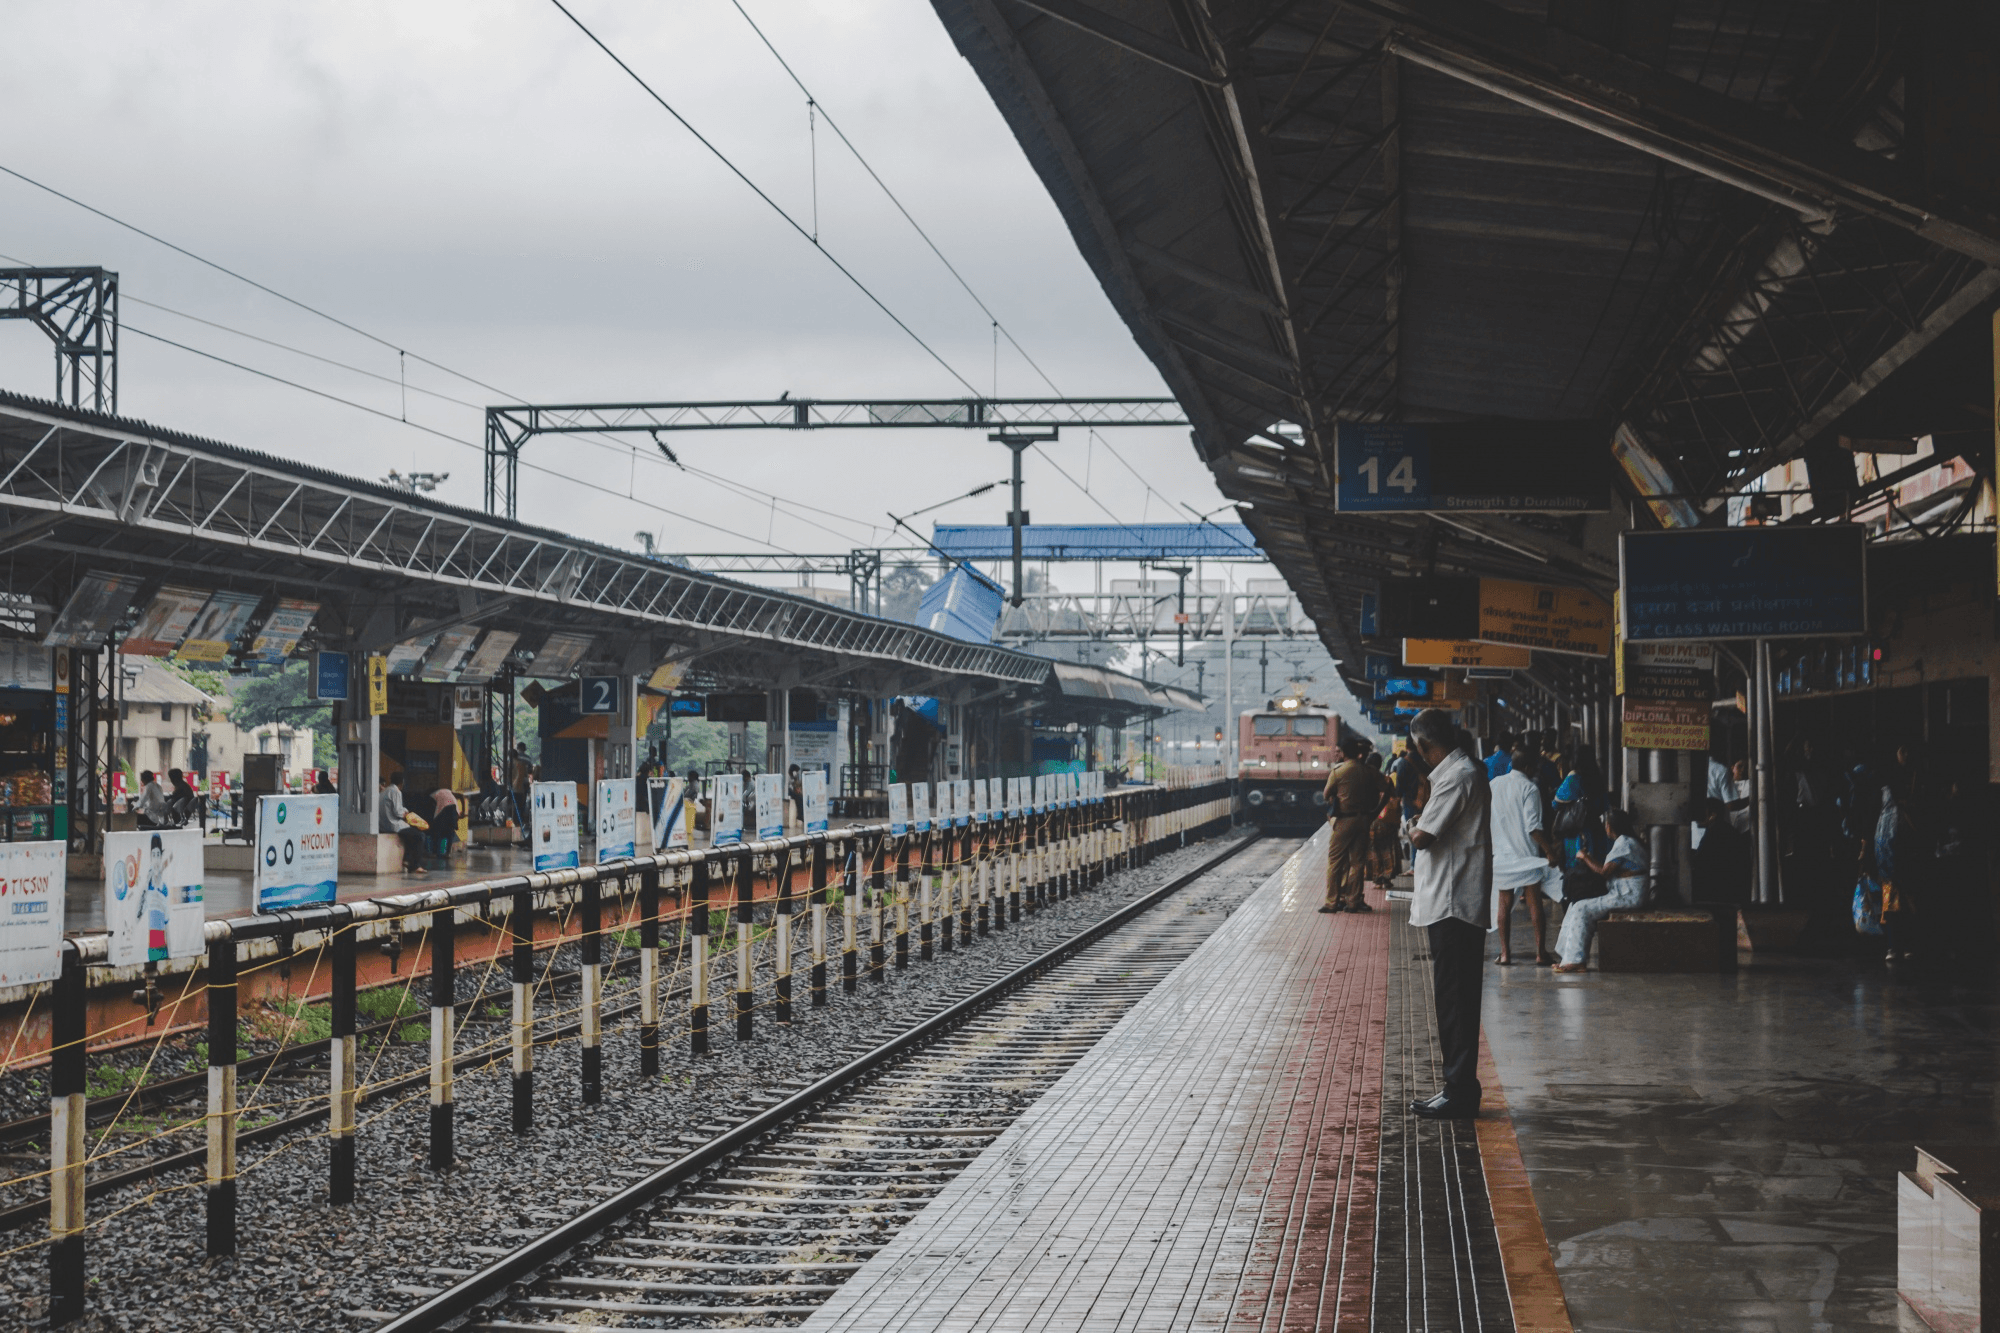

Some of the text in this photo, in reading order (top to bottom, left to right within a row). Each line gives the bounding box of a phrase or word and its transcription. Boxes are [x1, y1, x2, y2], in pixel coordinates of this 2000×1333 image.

[1358, 456, 1417, 494] 14
[1447, 497, 1589, 509] Strength & Durability
[1654, 623, 1703, 636] CLASS
[1707, 621, 1774, 634] WAITING
[1779, 620, 1823, 632] ROOM
[1482, 630, 1599, 653] RESERVATION CHARTS
[1372, 664, 1388, 676] 16
[592, 681, 610, 710] 2
[1696, 714, 1709, 724] +2
[301, 833, 335, 851] HYCOUNT
[12, 876, 49, 896] TICSON
